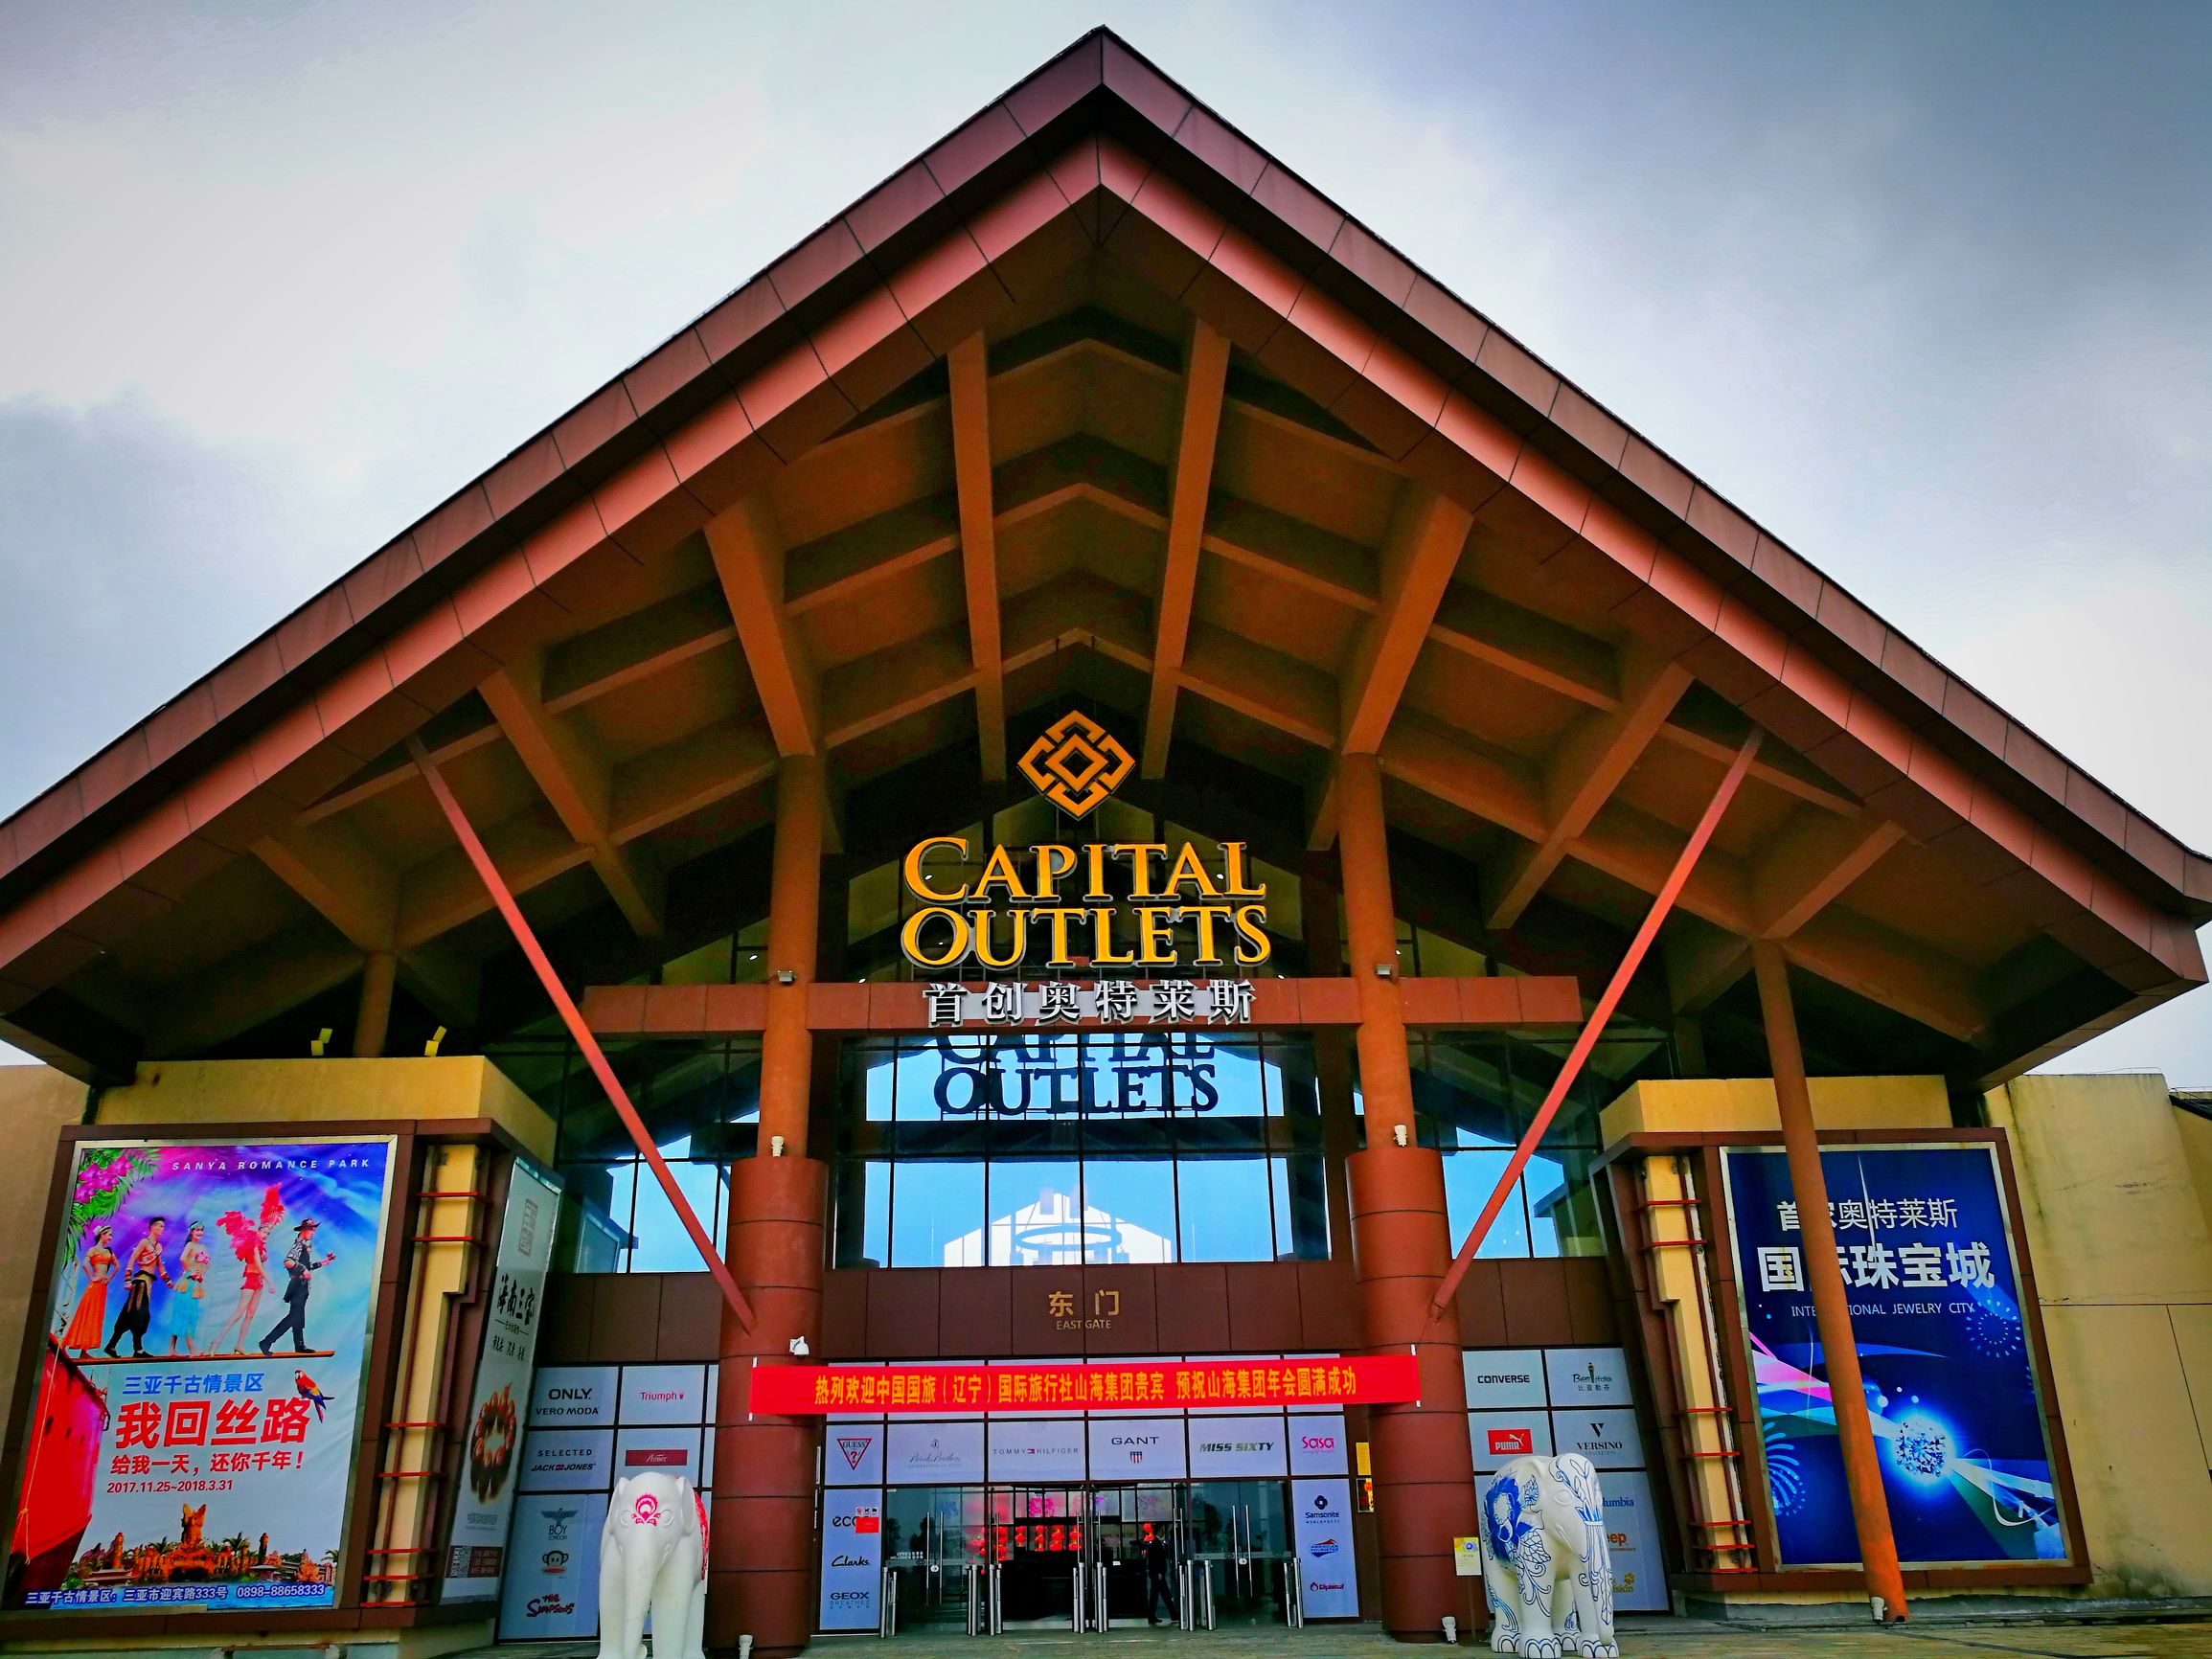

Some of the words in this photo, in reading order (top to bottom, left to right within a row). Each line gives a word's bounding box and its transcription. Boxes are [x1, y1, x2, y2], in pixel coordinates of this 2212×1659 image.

[904, 836, 1266, 901] CAPITAL
[901, 904, 1271, 968] OUTLETS
[923, 979, 1256, 1027] 首创奥特莱斯
[933, 1063, 1219, 1116] OUTLETS
[171, 1161, 226, 1170] SANYA
[239, 1160, 317, 1170] ROMANCE
[329, 1158, 369, 1168] PARK
[1791, 1304, 1886, 1317] INTEIONAL
[1892, 1304, 1942, 1314] JEWELRY
[1949, 1303, 1974, 1313] CITY
[1057, 1320, 1082, 1330] EAST
[1084, 1319, 1111, 1329] GATE
[123, 1373, 264, 1395] 三亚千古情景区
[1175, 1365, 1357, 1399] 预祝山海集团年会圆满成功
[1477, 1375, 1531, 1384] CONVERSE
[640, 1391, 676, 1402] Triumph
[536, 1407, 564, 1416] VERO
[115, 1397, 311, 1449] 我回丝路
[1111, 1437, 1159, 1445] GANT
[1495, 1442, 1520, 1451] PUMA
[1577, 1442, 1623, 1450] VERSINO
[537, 1448, 593, 1457] SELECTED
[1199, 1443, 1232, 1452] MISS
[1234, 1442, 1274, 1451] SIXTY
[563, 1463, 595, 1471] JONES
[106, 1480, 233, 1493] 2017.11.25~2018.3.31
[549, 1525, 567, 1534] BOY
[832, 1556, 870, 1566] Clarks
[237, 1583, 325, 1597] 0898-88658333
[831, 1591, 870, 1600] GEOX
